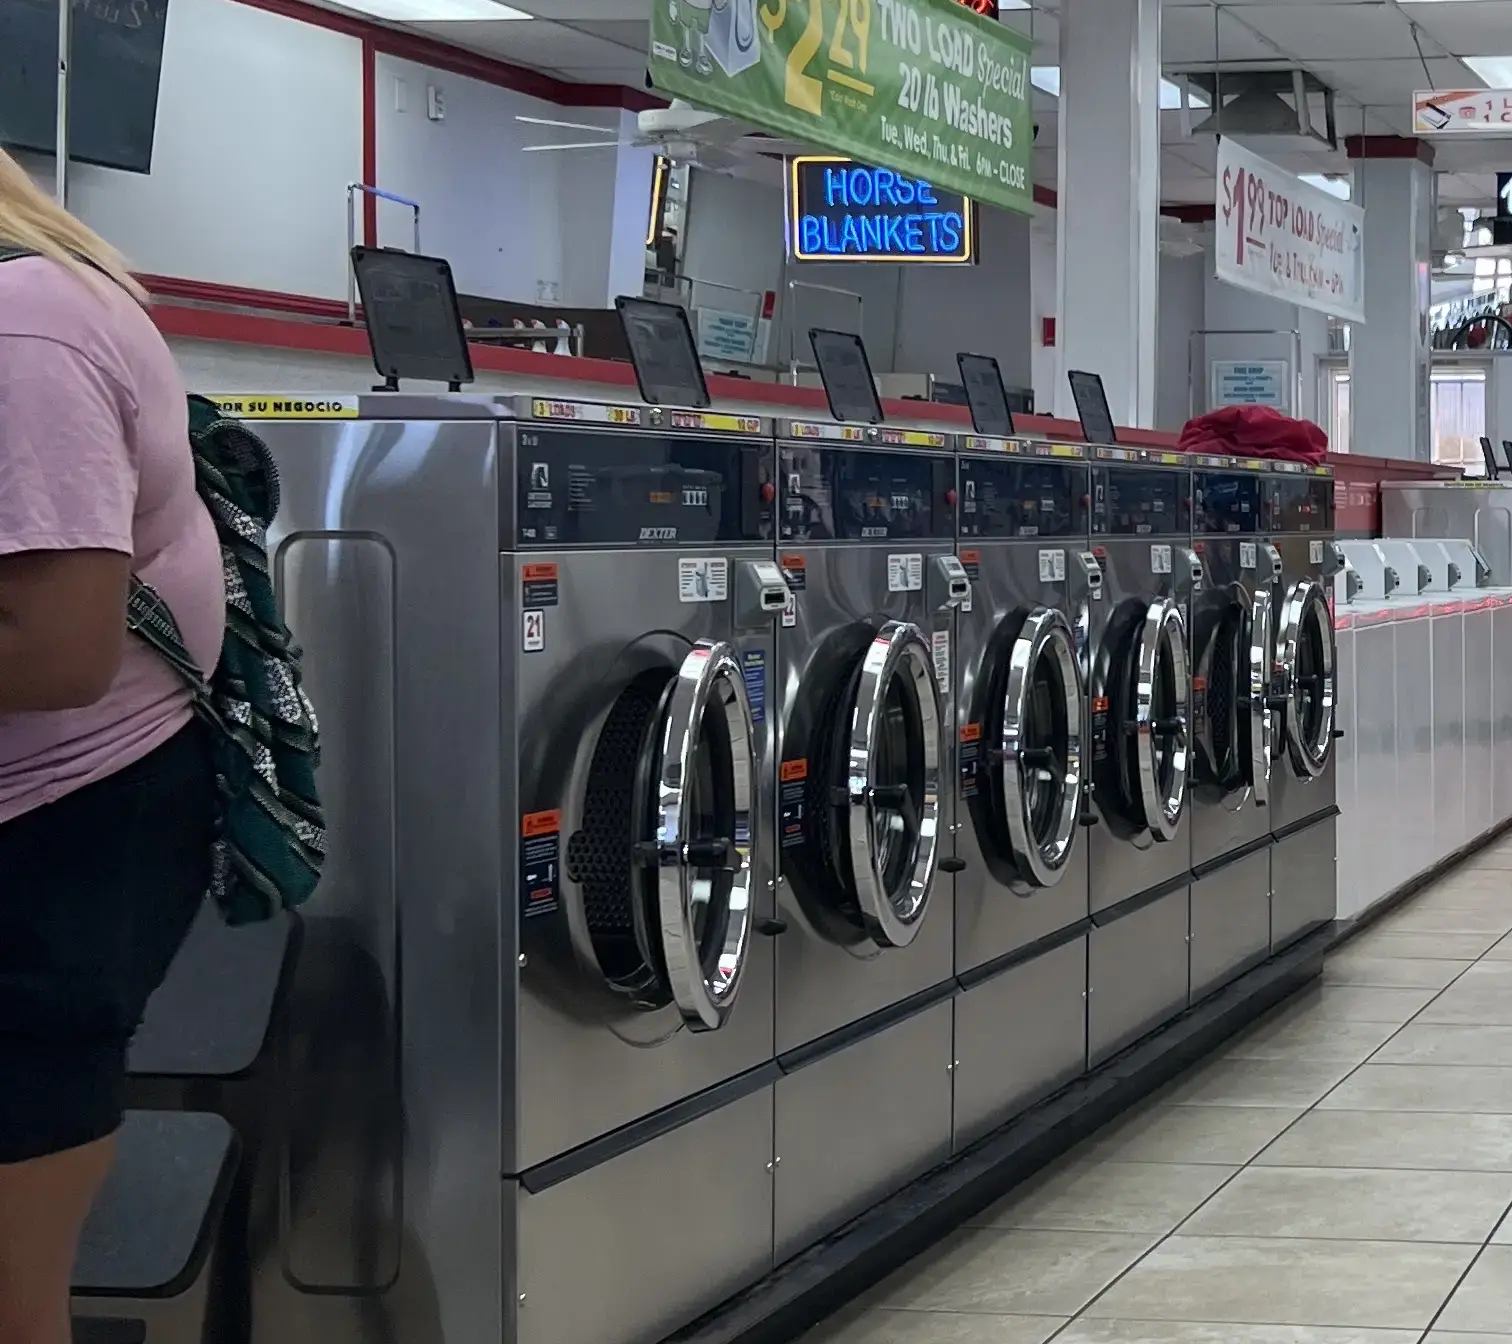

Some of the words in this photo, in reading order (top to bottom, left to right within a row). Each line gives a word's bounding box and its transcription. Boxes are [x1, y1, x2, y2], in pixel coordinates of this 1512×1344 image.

[925, 16, 974, 78] LOAD
[977, 42, 1027, 101] Special
[898, 62, 922, 112] 20
[923, 73, 940, 121] lb
[942, 80, 1013, 149] Washers
[824, 167, 938, 207] HORSE
[950, 143, 958, 167] &
[999, 159, 1026, 190] CLOSE
[801, 211, 963, 253] BLANKETS
[1268, 190, 1288, 230] TOP
[1291, 202, 1314, 243] LOAD
[247, 401, 268, 413] SU
[272, 401, 343, 413] NEGOCIO
[640, 527, 677, 539] DEXTER
[526, 614, 541, 638] 21
